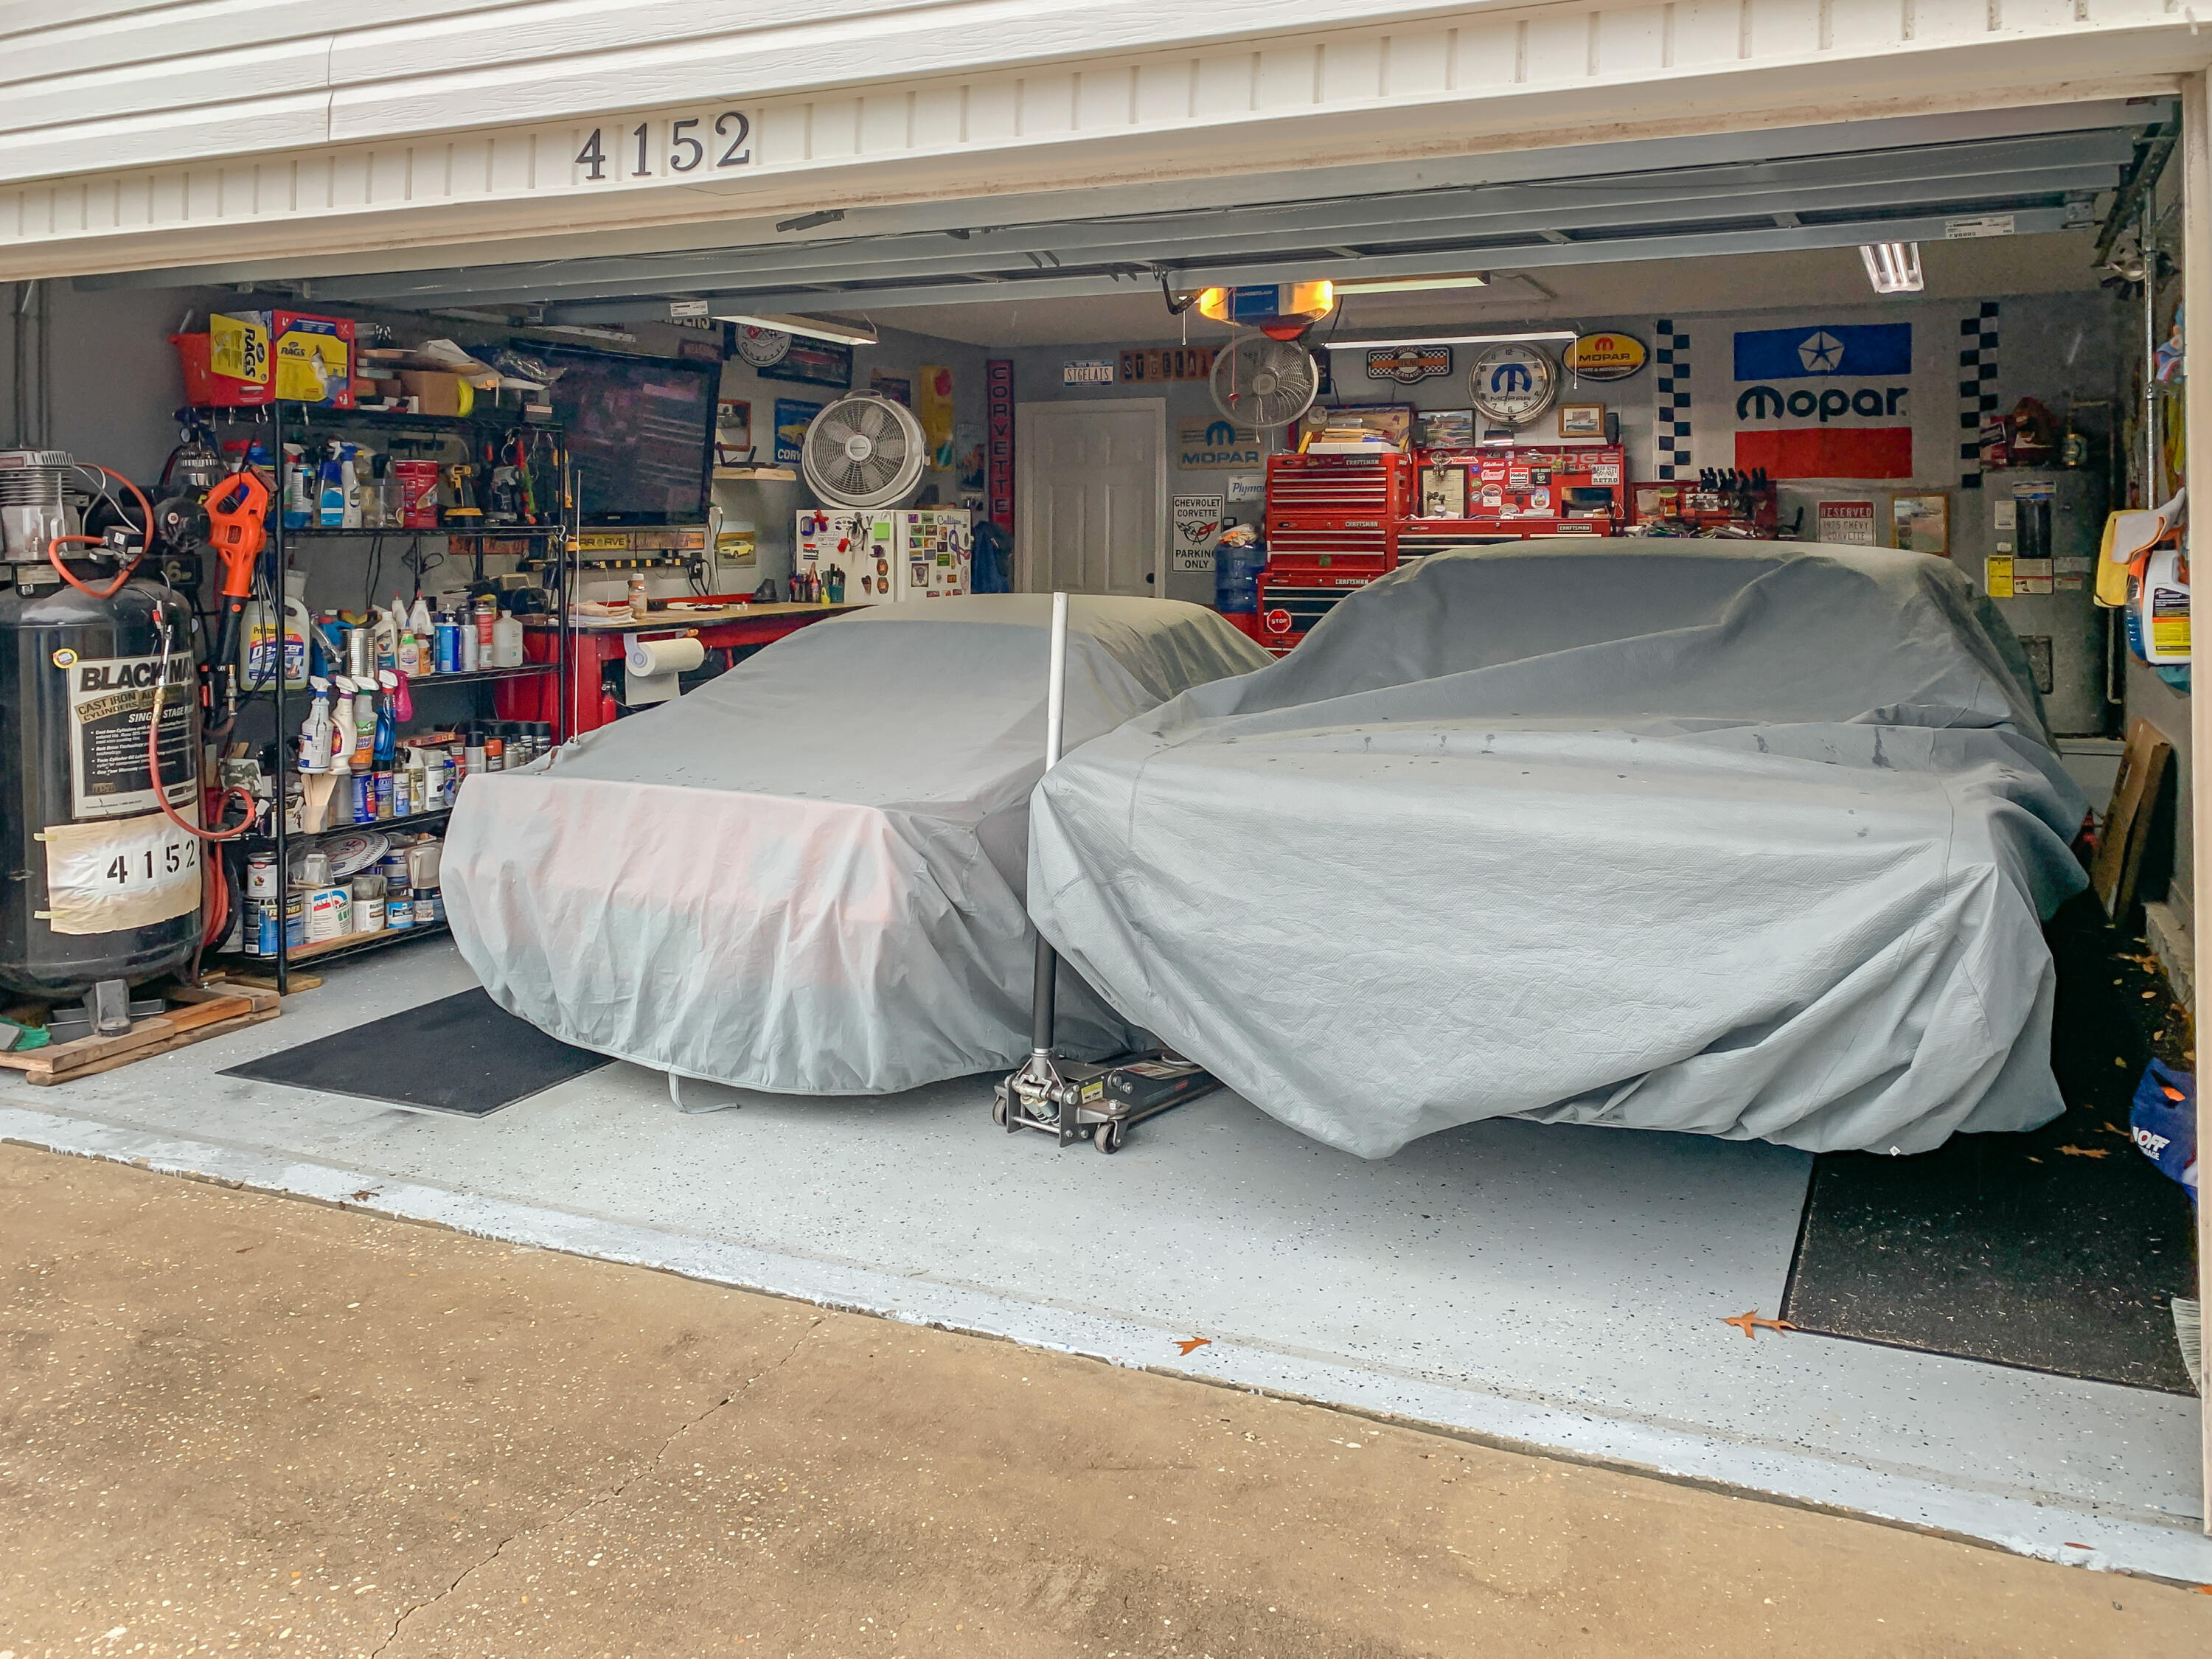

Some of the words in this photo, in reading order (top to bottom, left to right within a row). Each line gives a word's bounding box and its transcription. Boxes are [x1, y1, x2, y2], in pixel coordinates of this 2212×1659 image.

[574, 111, 751, 179] 4152
[245, 328, 256, 378] RAGS
[281, 347, 305, 356] RAGS
[1579, 353, 1630, 362] MOPAR
[991, 366, 1009, 513] CORVETTE
[1181, 451, 1260, 465] MOPAR
[1232, 481, 1267, 496] Plymo
[1175, 498, 1221, 507] CHEVROLET
[1177, 509, 1217, 517] CORVETTE
[1820, 507, 1872, 518] RESERVED
[1827, 532, 1865, 540] CORVETTE
[1184, 560, 1209, 568] ONLY
[80, 661, 164, 692] BLACK
[78, 698, 109, 715] CAST
[111, 692, 136, 708] IRON
[83, 701, 138, 721] CYLINDERS
[128, 712, 154, 723] SING
[162, 709, 184, 719] STAGE
[106, 839, 195, 884] 4152
